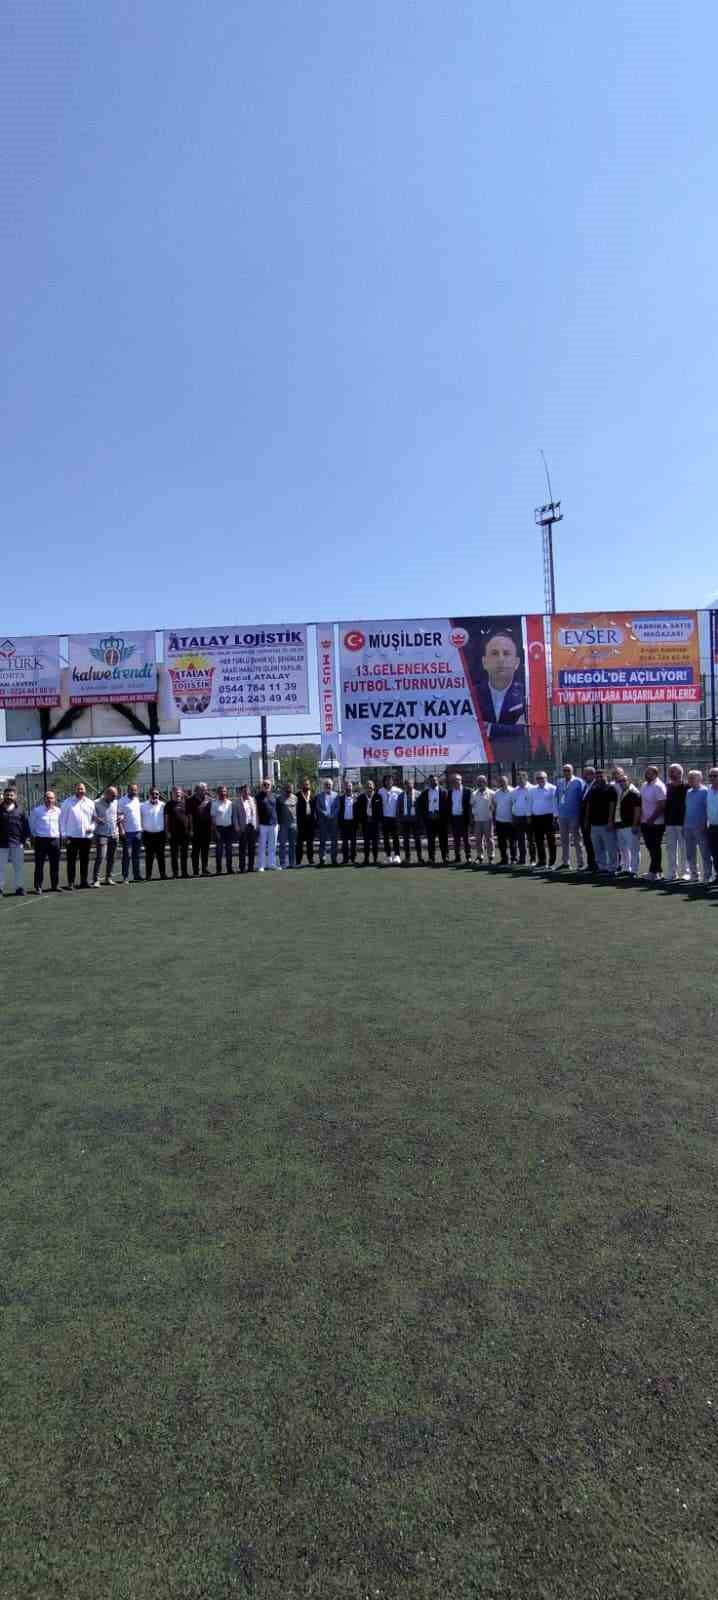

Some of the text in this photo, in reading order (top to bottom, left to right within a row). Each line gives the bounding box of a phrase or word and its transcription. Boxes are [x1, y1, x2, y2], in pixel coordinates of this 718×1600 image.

[168, 630, 304, 650] ATALAY LOJİSTİK
[369, 630, 442, 651] MUŞİLDER
[565, 630, 617, 645] EVSER
[254, 672, 289, 680] ATALAY
[356, 662, 453, 677] 13.GELENEKSEL
[219, 684, 244, 693] 0544
[219, 696, 244, 704] 0224
[345, 699, 473, 719] NEVZAT KAYA
[371, 722, 447, 740] SEZONU
[363, 745, 449, 761] Hoş Geldiniz
